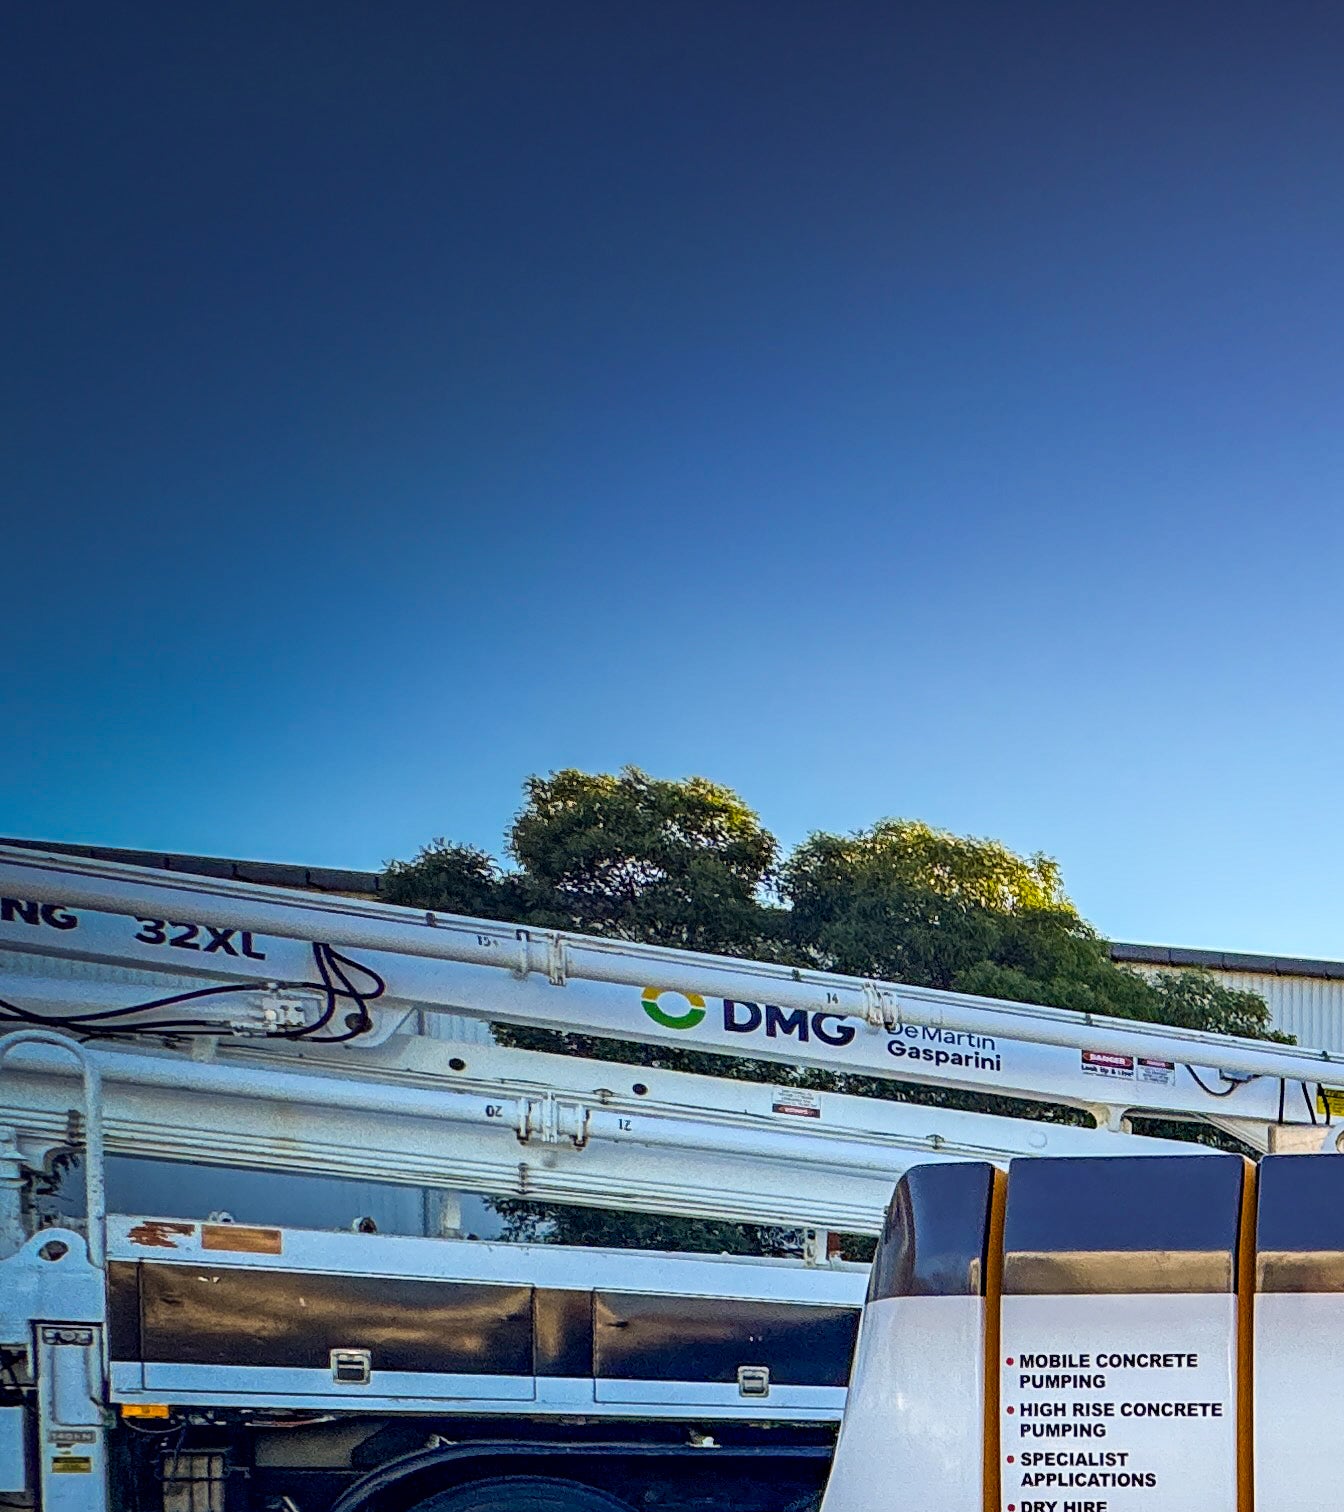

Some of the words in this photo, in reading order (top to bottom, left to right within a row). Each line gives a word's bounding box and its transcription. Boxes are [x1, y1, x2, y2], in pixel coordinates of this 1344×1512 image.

[134, 915, 266, 961] 32XL
[723, 999, 856, 1047] DMG
[887, 1039, 1001, 1071] Gasparini
[1019, 1354, 1090, 1369] MOBILE
[1096, 1354, 1199, 1368] CONCRETE
[1019, 1374, 1106, 1389] PUMPING
[1020, 1403, 1066, 1417] HIGH
[1072, 1403, 1115, 1417] RISE
[1120, 1403, 1224, 1417] CONCRETE
[1020, 1423, 1107, 1438] PUMPING
[1020, 1452, 1129, 1467] SPECIALIST
[1021, 1473, 1157, 1488] APPLICATIONS
